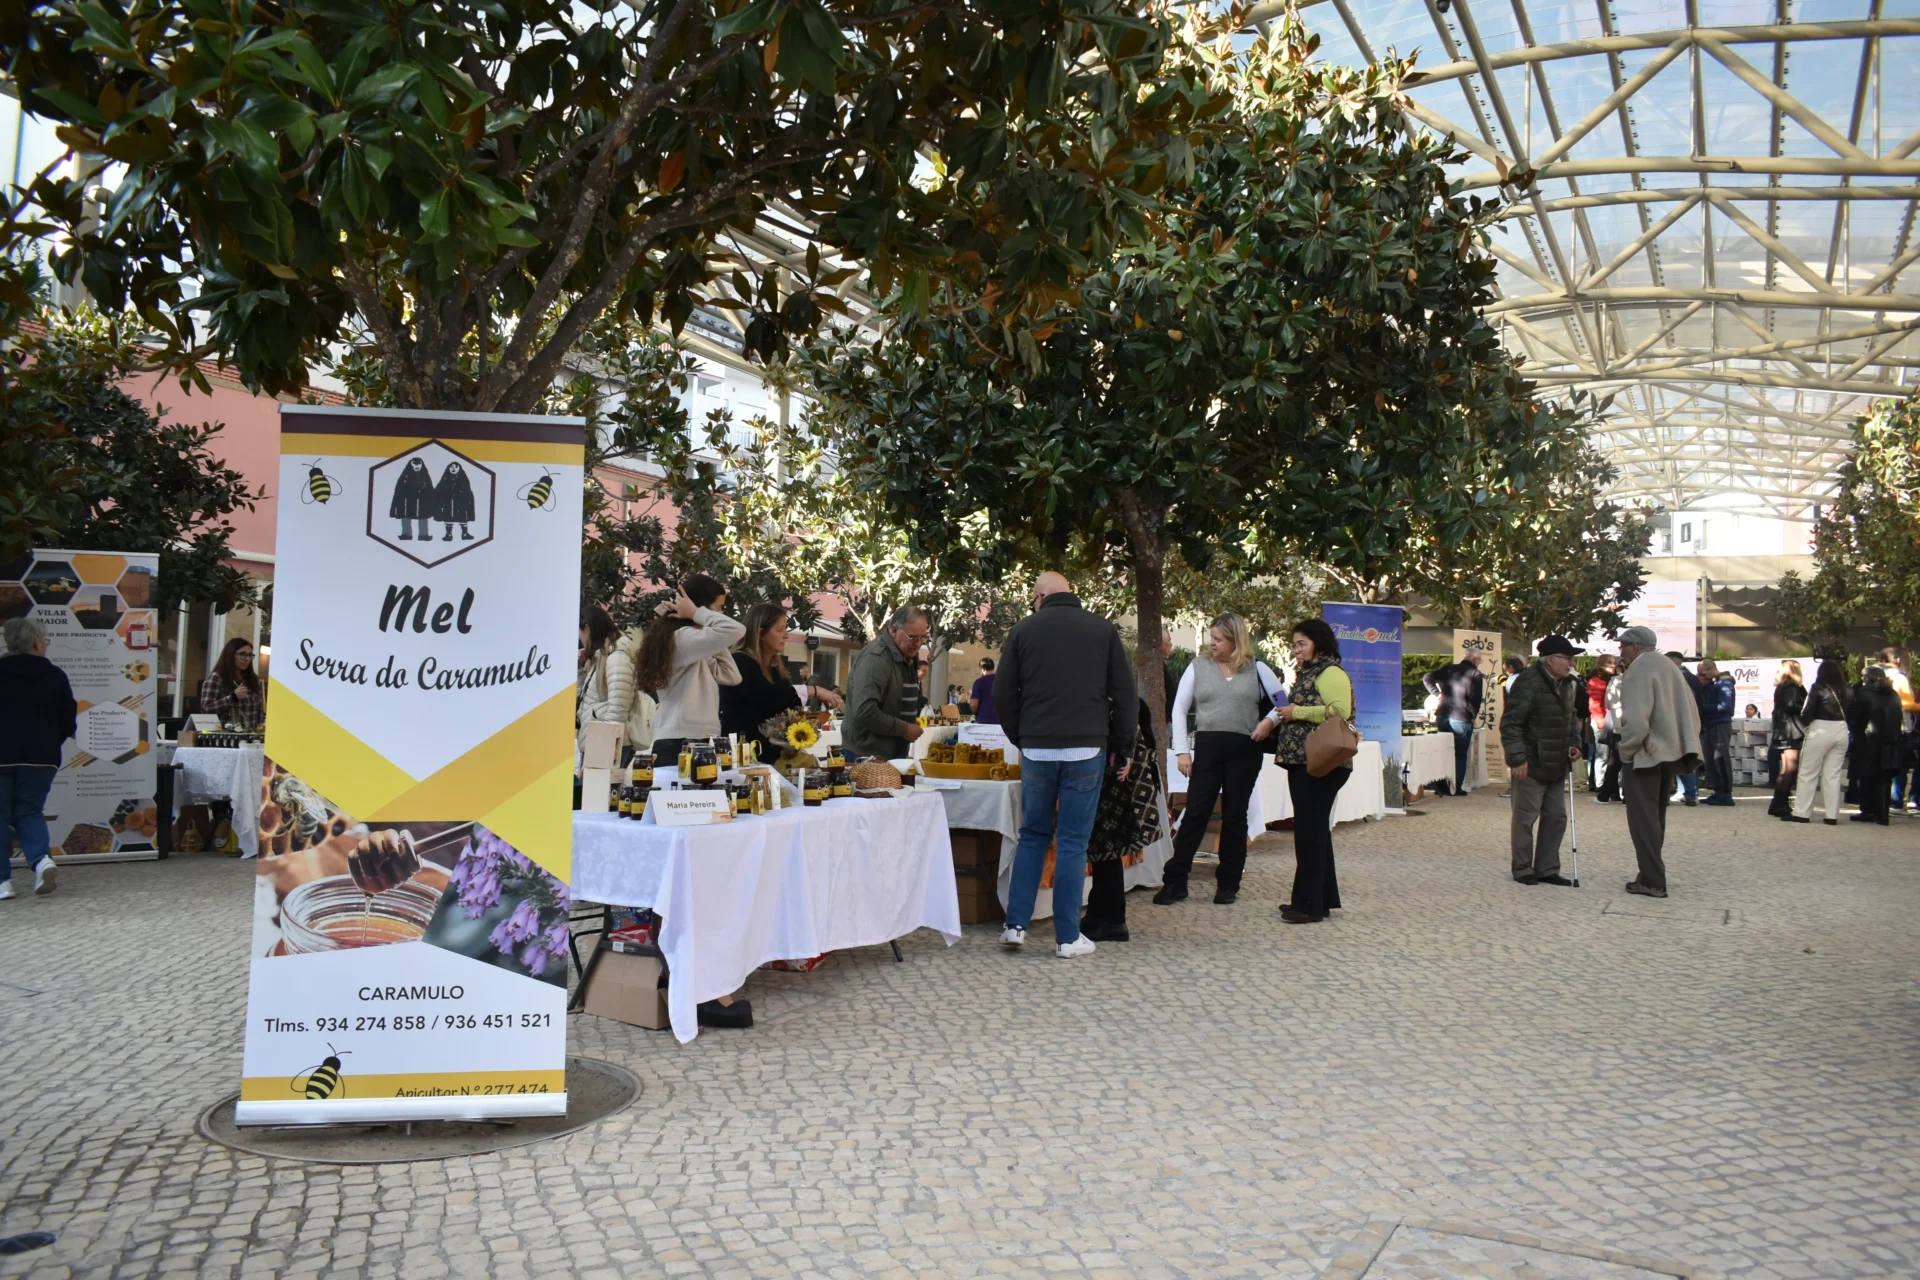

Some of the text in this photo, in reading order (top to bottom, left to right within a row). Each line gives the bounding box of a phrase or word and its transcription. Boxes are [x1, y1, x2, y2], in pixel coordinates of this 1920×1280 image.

[37, 609, 67, 617] VILAR
[378, 584, 475, 635] Mel
[36, 618, 69, 626] MAIOR
[295, 638, 551, 691] Serra do Caramulo
[1734, 668, 1760, 683] Mel
[358, 985, 465, 1002] CARAMULO
[264, 1013, 551, 1033] Tlms. 934 274 858 / 936 451 521
[395, 1087, 458, 1098] Apicultor
[484, 1084, 515, 1096] 277
[517, 1083, 549, 1094] 474
